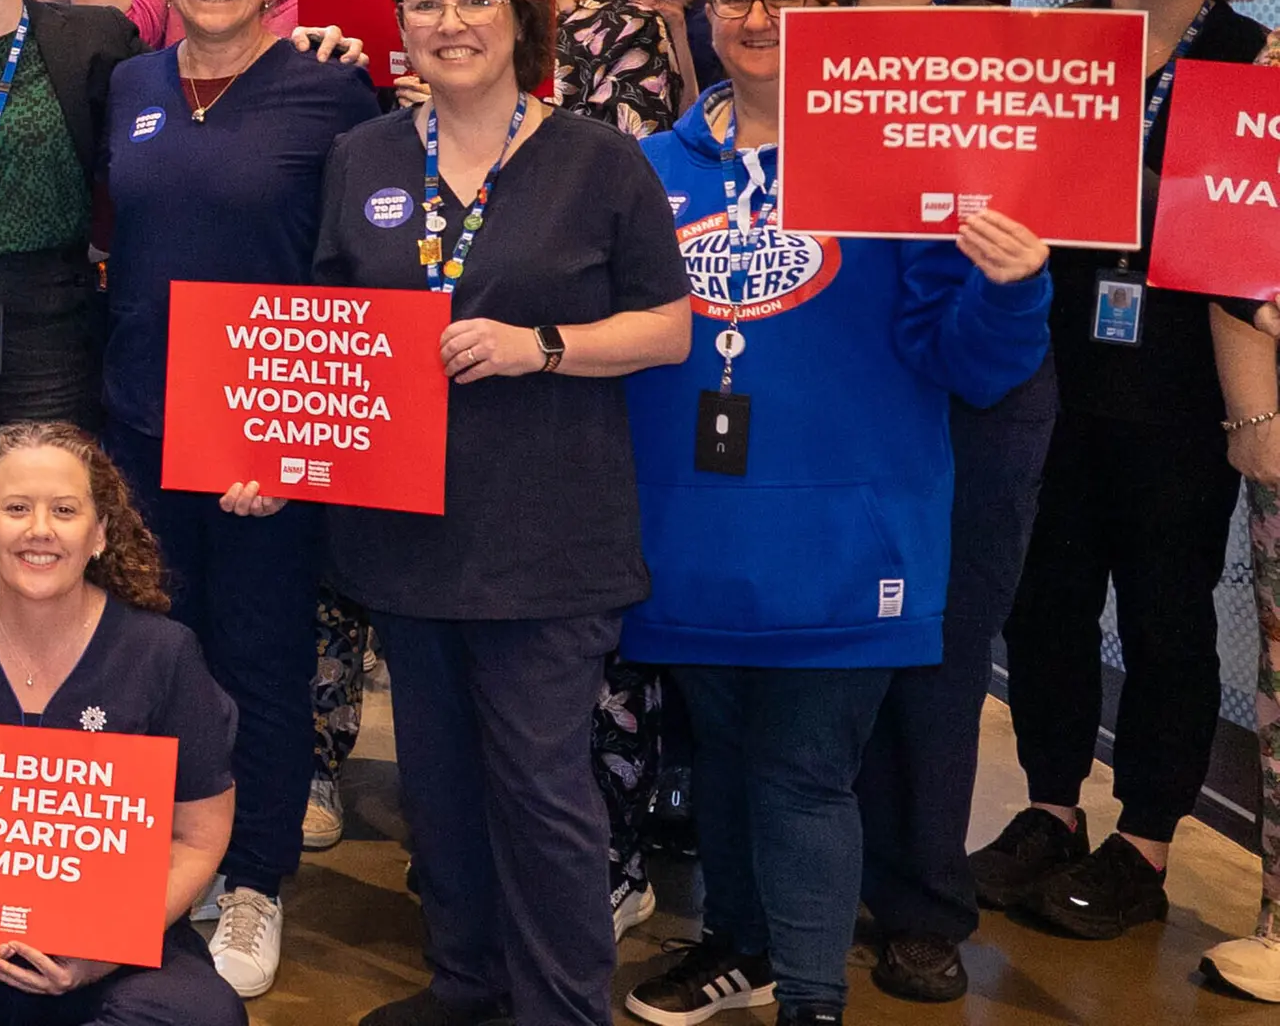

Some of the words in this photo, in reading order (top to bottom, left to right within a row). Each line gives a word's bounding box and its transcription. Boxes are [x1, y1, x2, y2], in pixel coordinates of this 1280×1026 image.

[822, 56, 1115, 86] MARYBOROUGH
[806, 89, 967, 115] DISTRICT
[976, 90, 1120, 121] HEALTH
[883, 122, 1038, 151] SERVICE
[681, 215, 724, 238] ANMF
[685, 227, 806, 254] NUSES
[684, 249, 810, 274] MIDIVES
[690, 267, 805, 300] CAERS
[249, 296, 371, 325] ALBURY
[708, 304, 732, 317] MY
[225, 325, 393, 358] WODONGA
[248, 356, 370, 393] HEALTH,
[223, 386, 391, 421] WODONGA
[243, 417, 371, 451] CAMPUS
[284, 466, 304, 474] ANMF
[11, 786, 155, 829] HEALTH,
